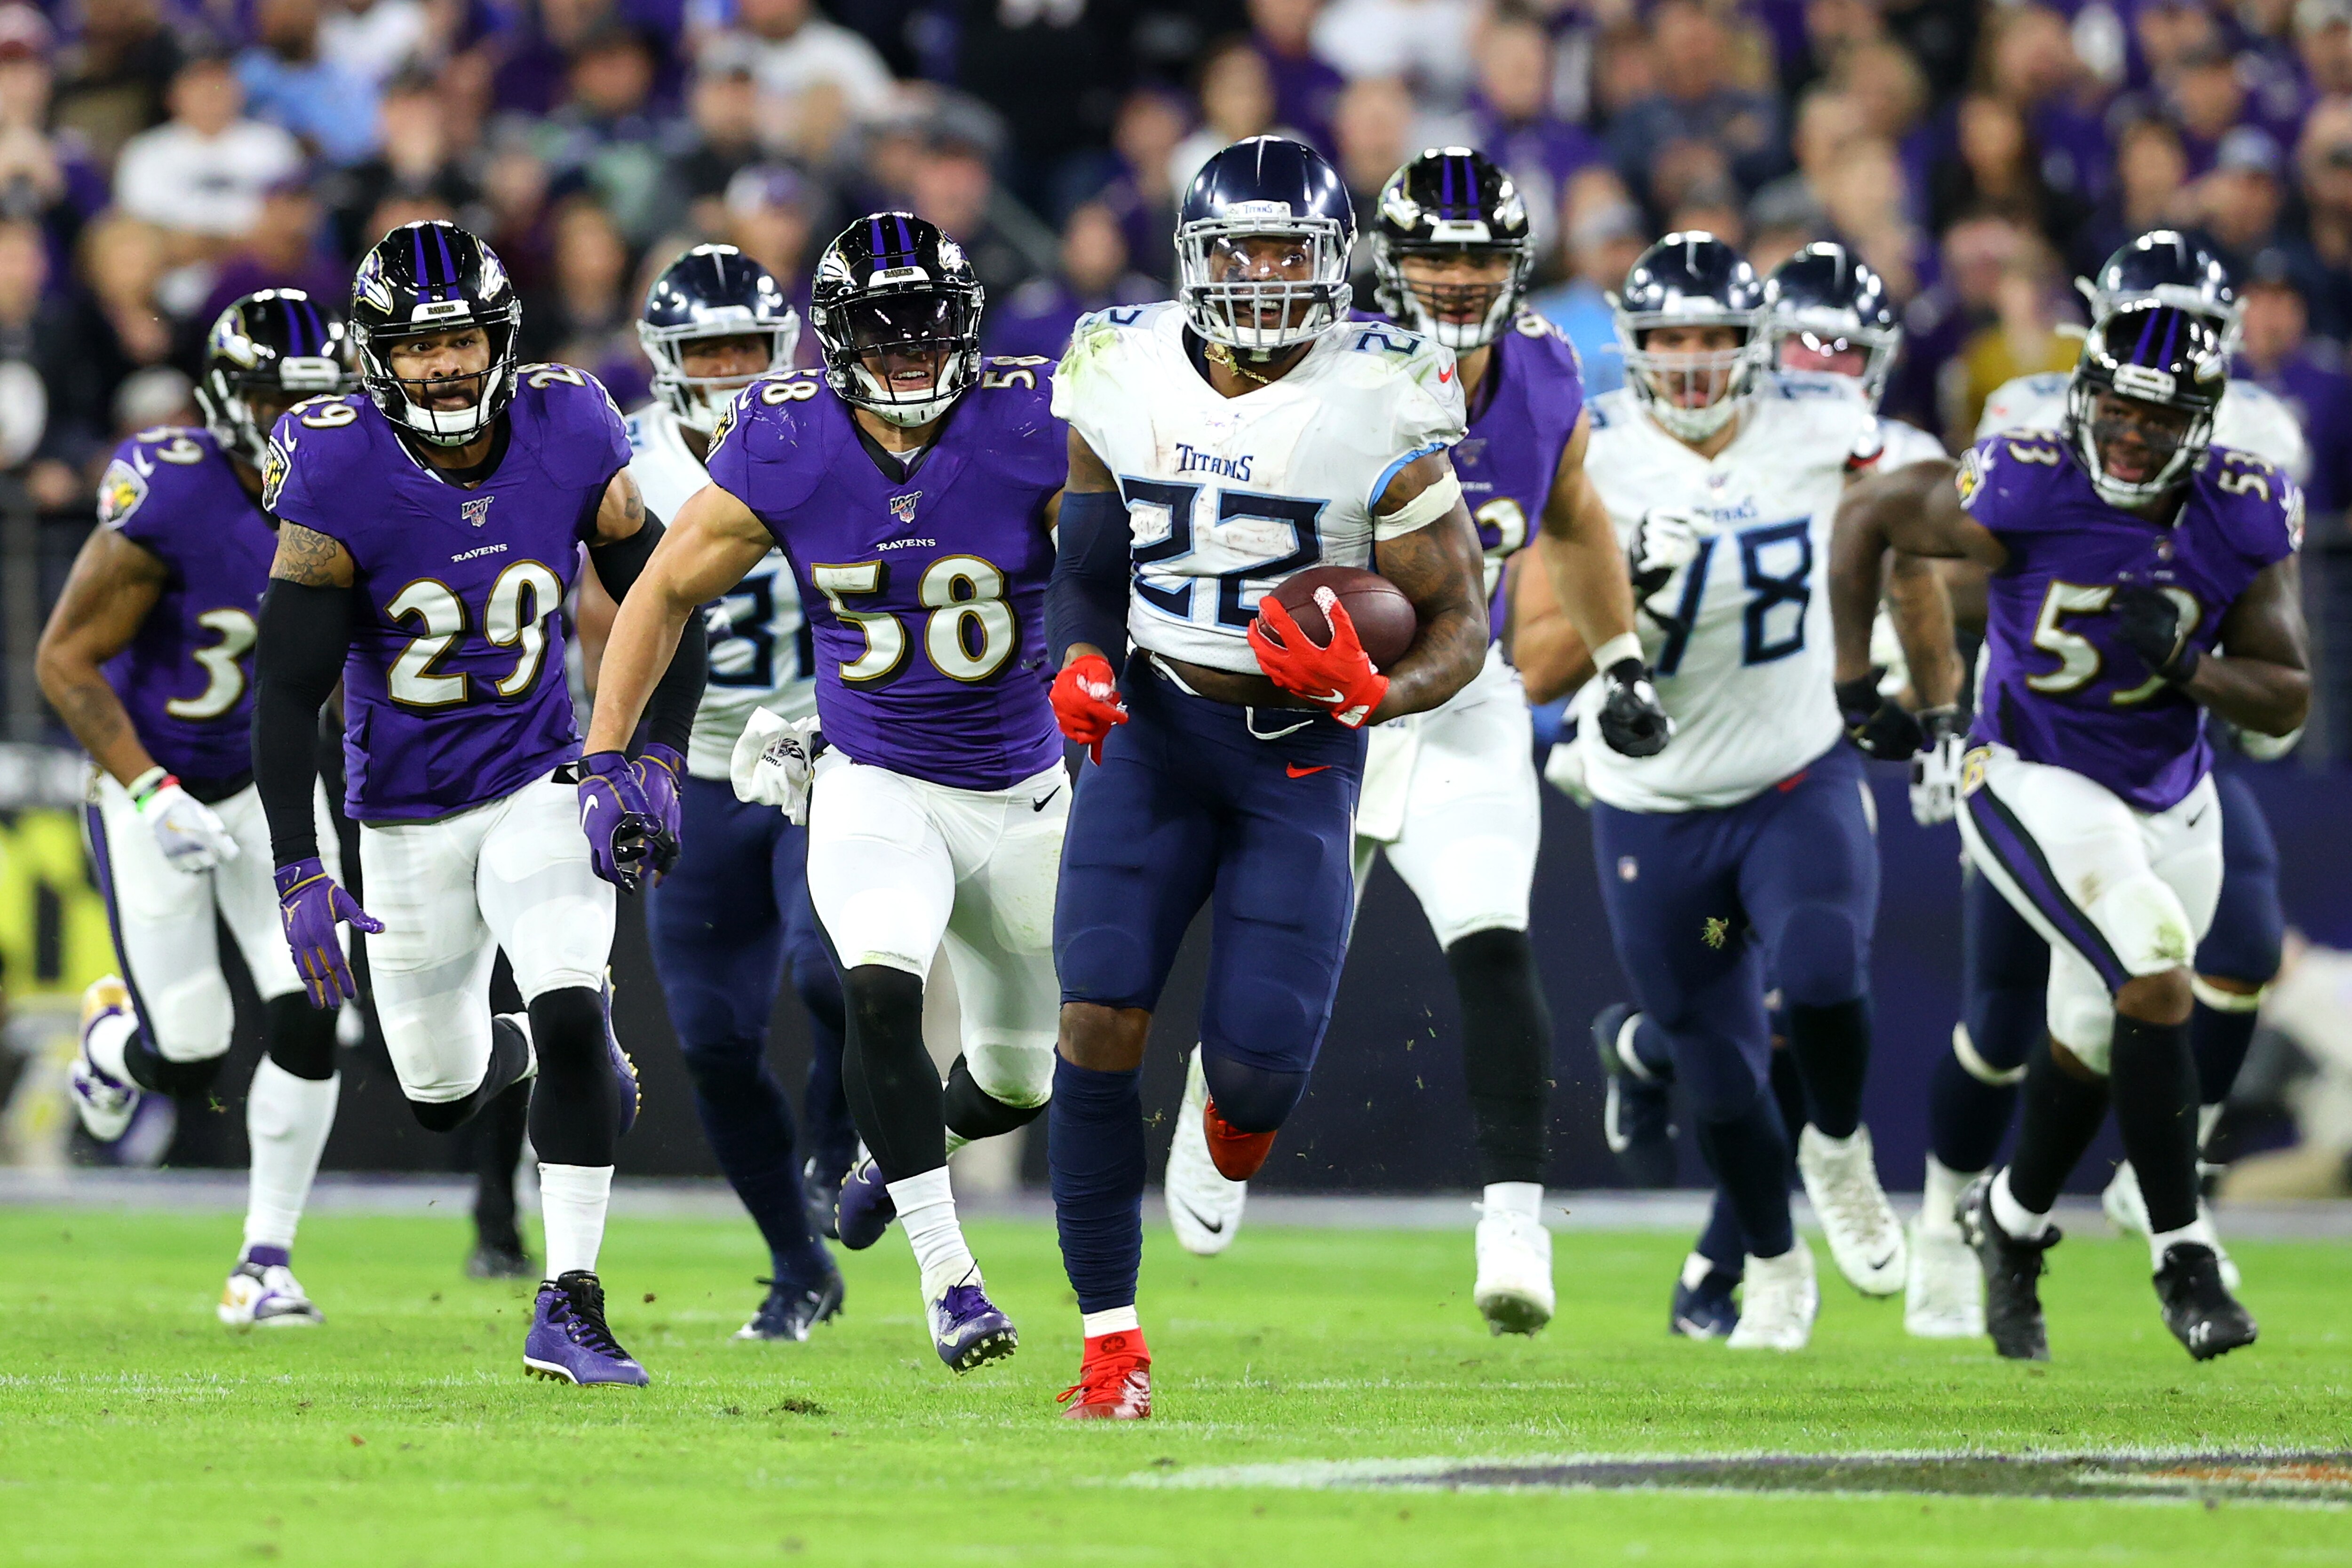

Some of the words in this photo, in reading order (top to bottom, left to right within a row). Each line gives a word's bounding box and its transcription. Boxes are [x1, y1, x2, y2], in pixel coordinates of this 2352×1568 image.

[1242, 204, 1272, 214] TITANS
[981, 355, 1050, 390] 58
[1176, 442, 1255, 482] TITANS
[451, 543, 508, 563] RAVENS
[876, 538, 936, 551] RAVENS
[1119, 474, 1331, 630] 22
[383, 559, 562, 707] 29
[810, 554, 1015, 682] 58
